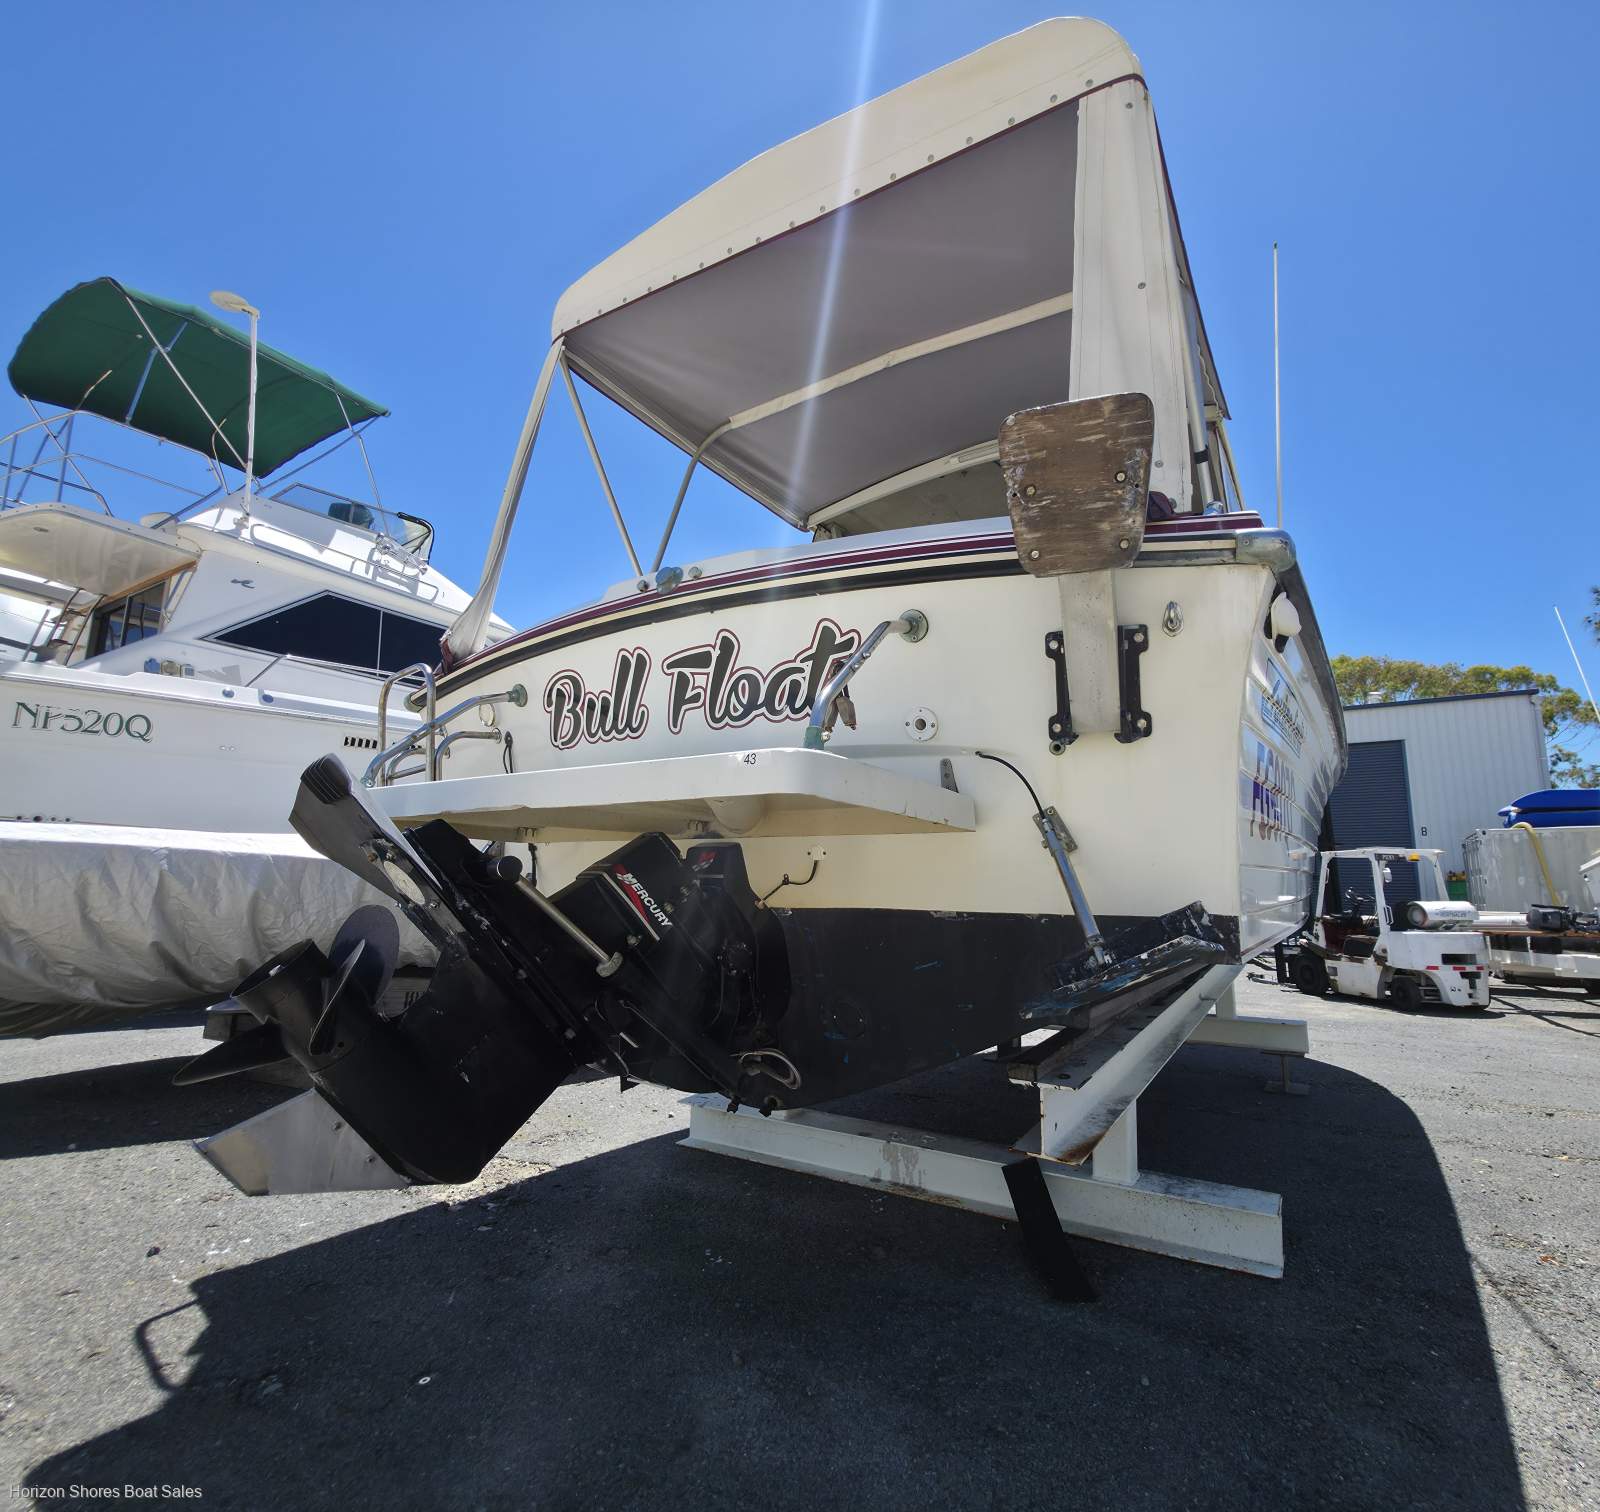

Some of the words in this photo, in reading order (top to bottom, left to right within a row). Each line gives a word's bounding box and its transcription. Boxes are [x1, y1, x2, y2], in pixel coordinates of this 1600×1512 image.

[543, 646, 651, 750] Bull
[662, 617, 862, 734] Float
[616, 871, 673, 927] MERCURY
